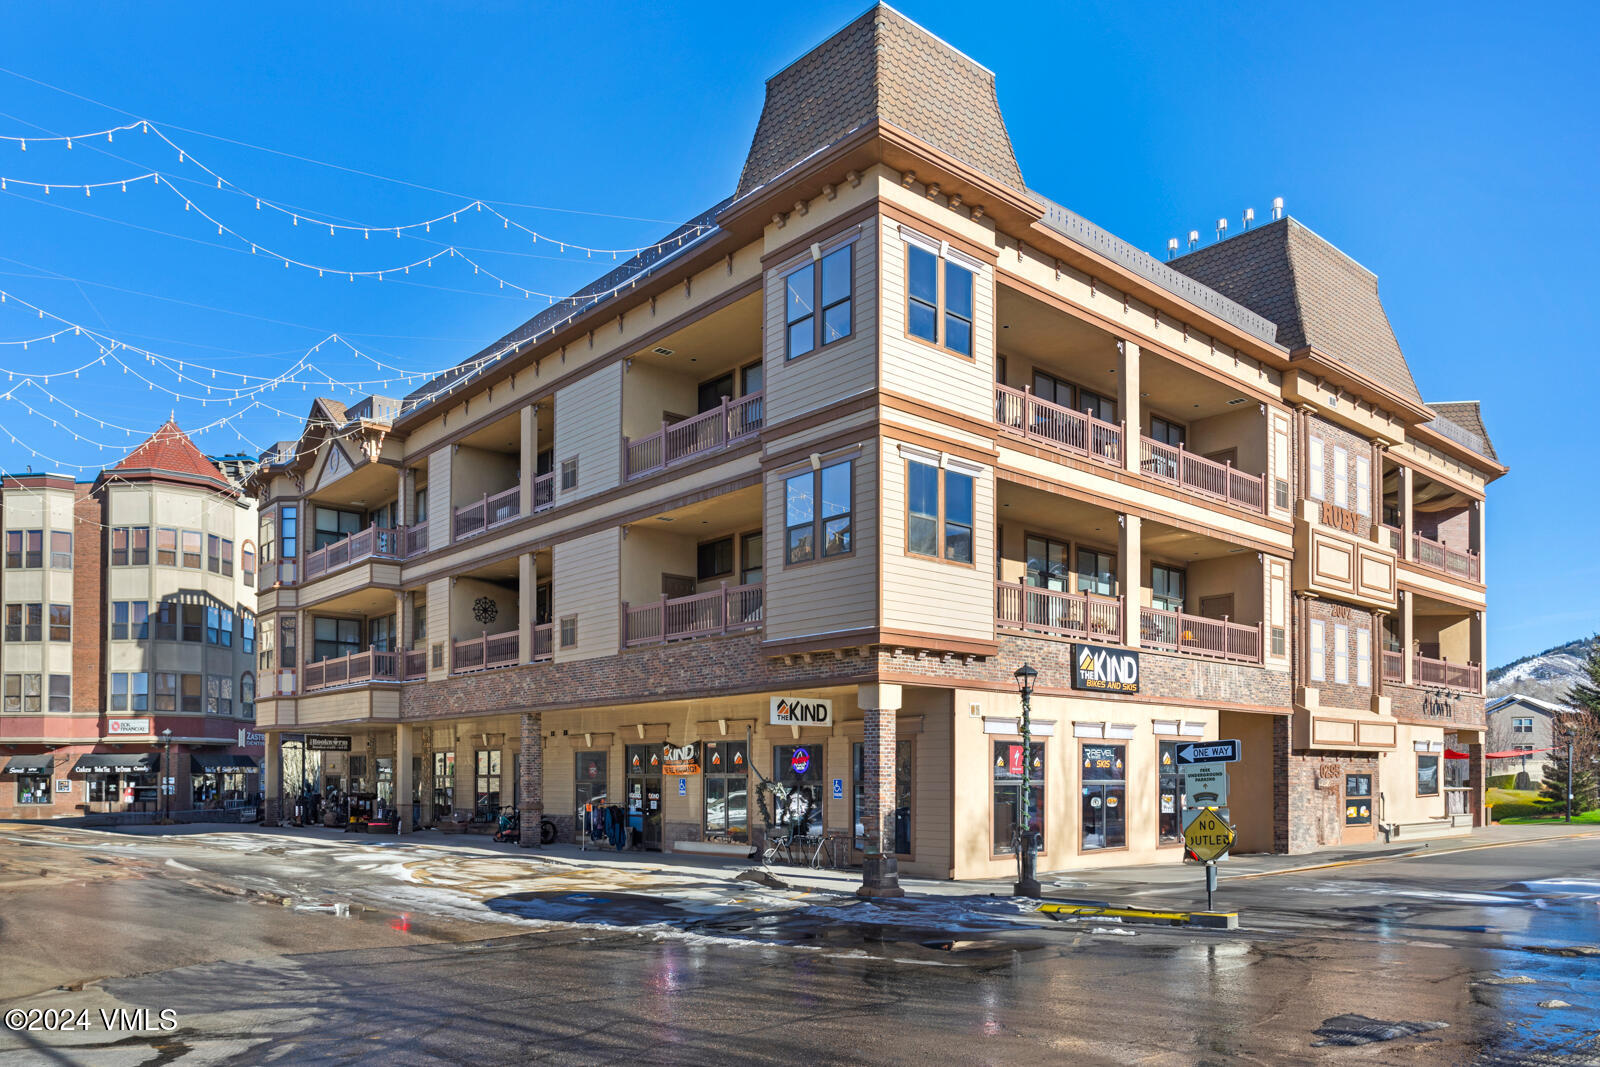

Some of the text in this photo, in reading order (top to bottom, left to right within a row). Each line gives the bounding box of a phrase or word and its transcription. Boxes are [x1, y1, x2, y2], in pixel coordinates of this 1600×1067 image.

[1321, 502, 1361, 535] RUBY
[1328, 604, 1353, 620] 2002
[1080, 649, 1138, 685] THE KIND
[1086, 679, 1138, 692] BIKES AND SKIS
[790, 700, 828, 722] KIND
[667, 744, 695, 761] KIND
[1193, 746, 1230, 758] ONE WAY
[1096, 759, 1111, 768] SKIS
[1199, 820, 1215, 831] NO
